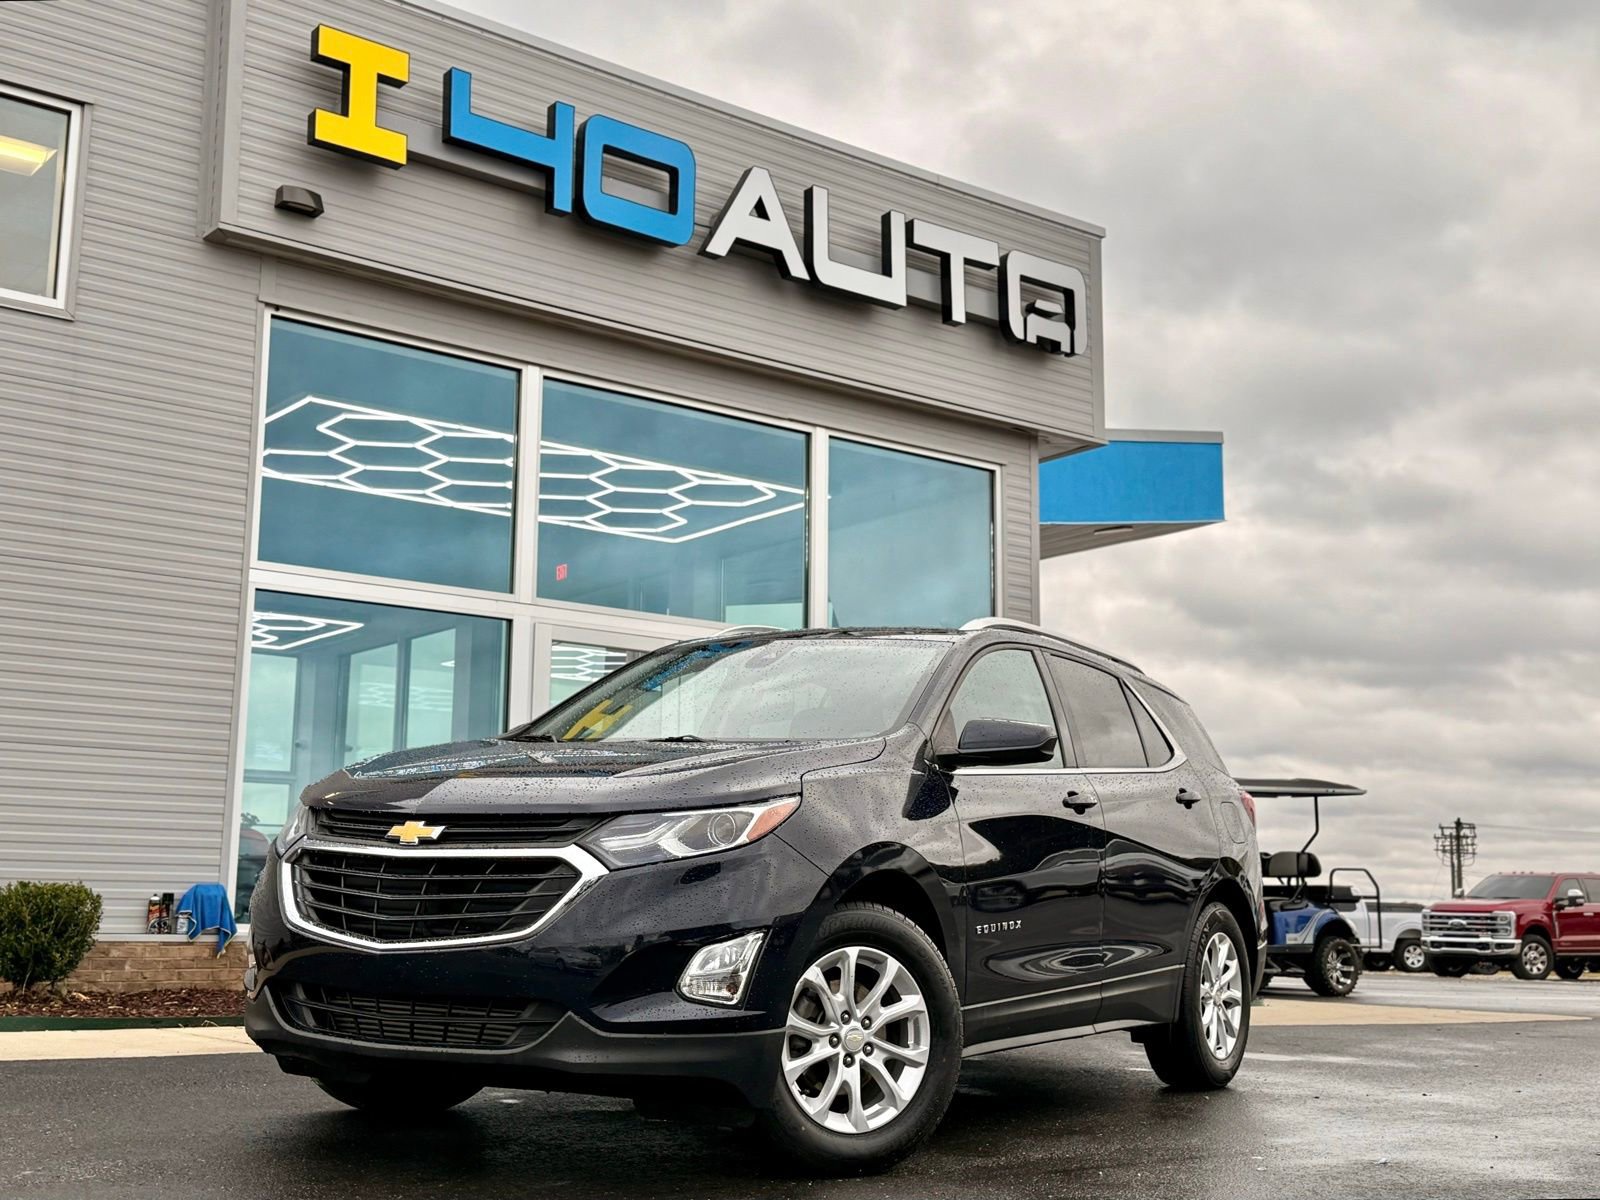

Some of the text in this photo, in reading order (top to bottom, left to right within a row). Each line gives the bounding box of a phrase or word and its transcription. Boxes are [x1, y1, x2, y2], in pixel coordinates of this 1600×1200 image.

[308, 23, 1088, 357] I 40 AUTO
[976, 920, 1022, 935] EQUINOX
